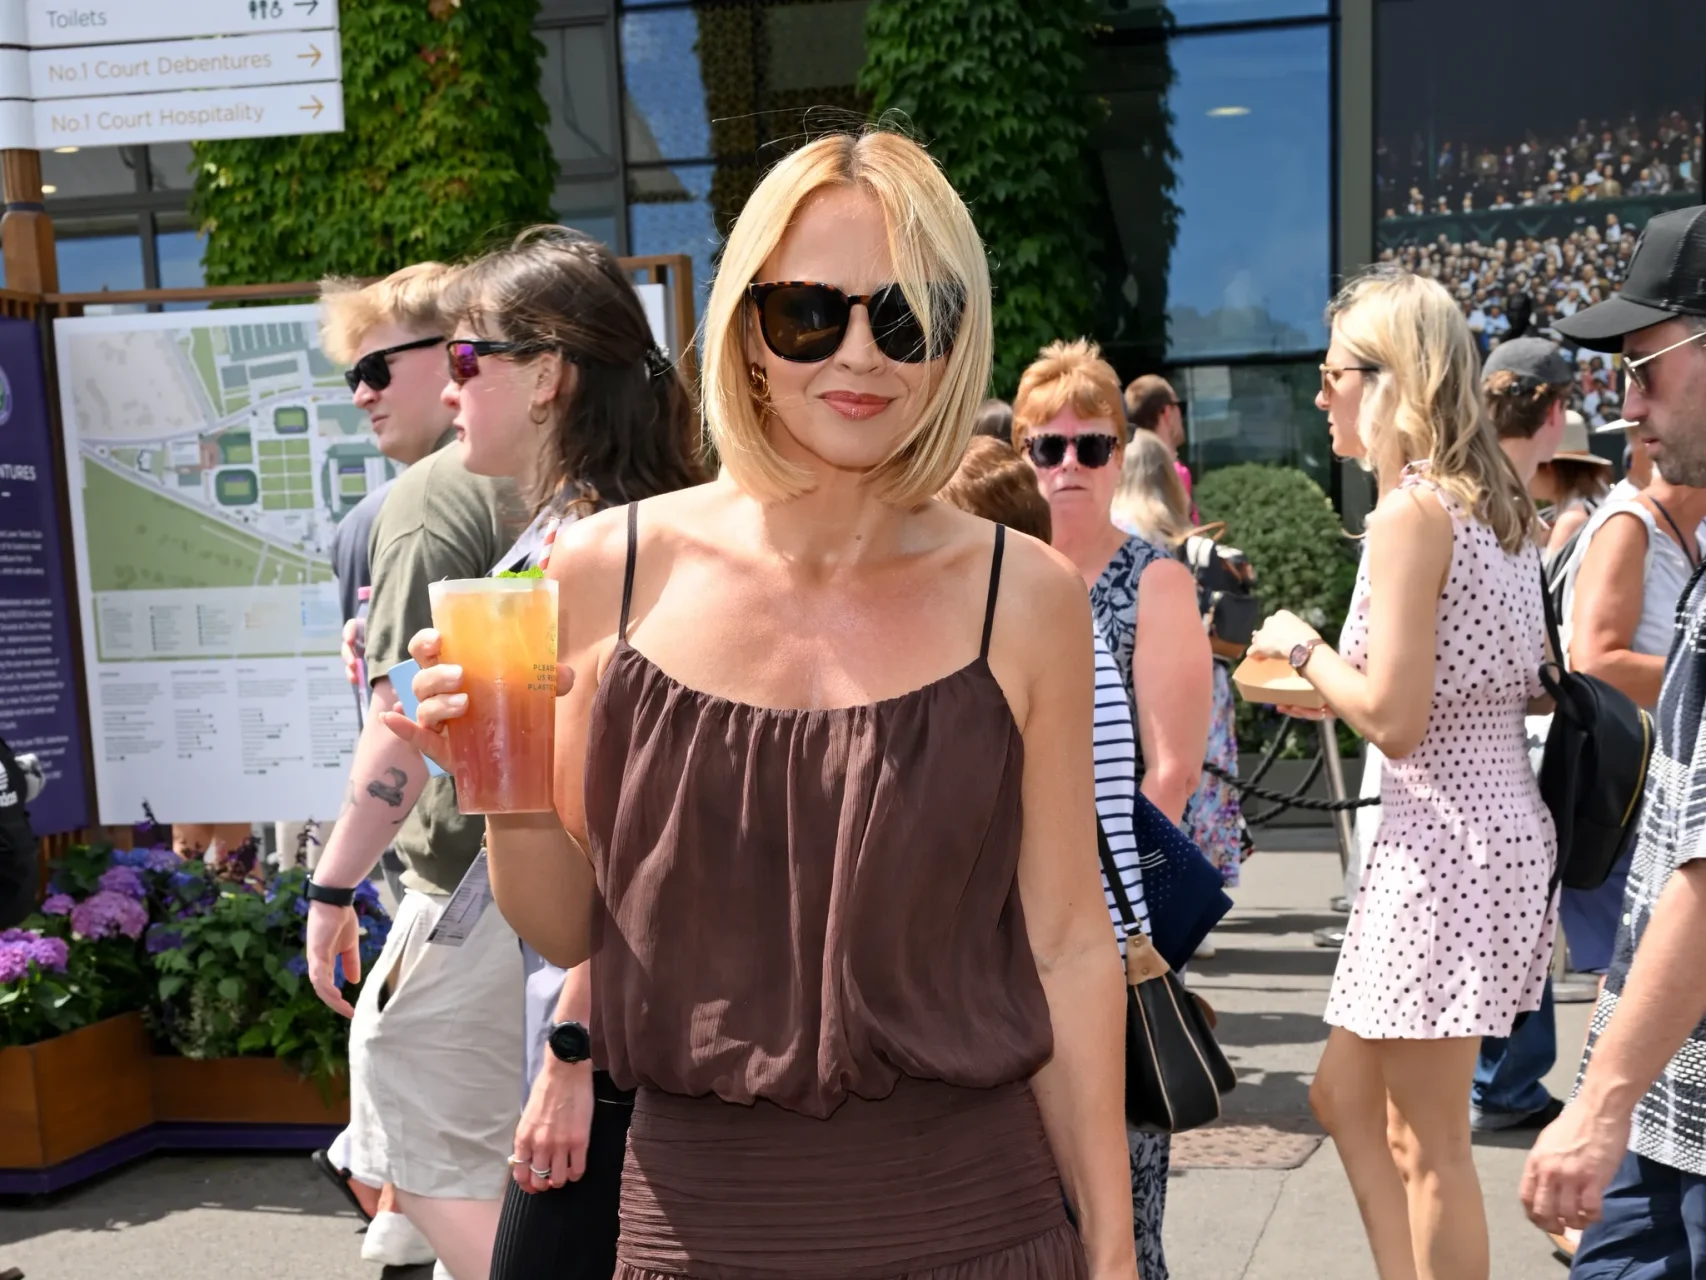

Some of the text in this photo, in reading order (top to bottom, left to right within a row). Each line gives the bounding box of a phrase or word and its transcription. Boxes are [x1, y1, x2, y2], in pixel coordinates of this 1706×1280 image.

[46, 9, 108, 29] Toilets
[48, 52, 272, 83] No.1 Court Debentures
[51, 104, 264, 133] No.1 Court Hospitality
